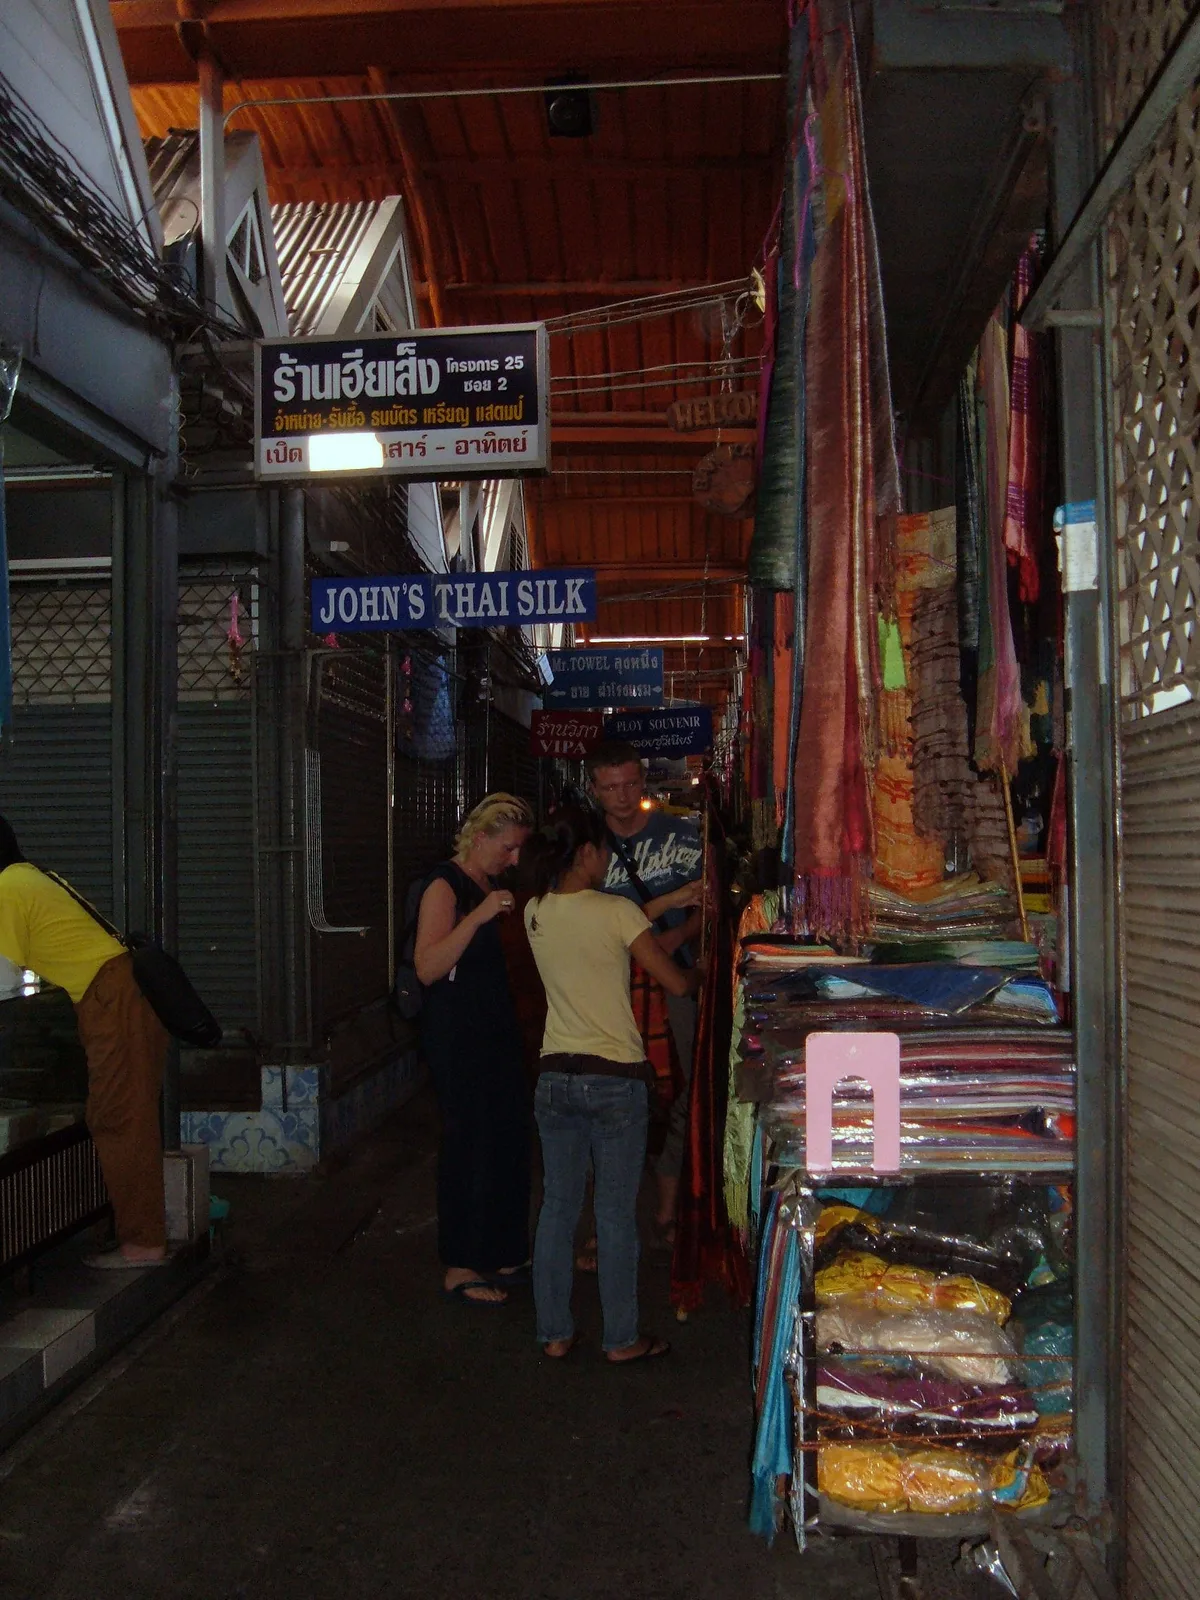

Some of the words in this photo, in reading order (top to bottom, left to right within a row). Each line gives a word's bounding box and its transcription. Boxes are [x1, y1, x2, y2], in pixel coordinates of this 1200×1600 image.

[273, 342, 441, 403] ร้านเฮียเส็ง
[446, 357, 499, 374] โครงการ
[505, 355, 525, 371] 25
[464, 380, 492, 393] ซอย
[498, 377, 509, 392] 2
[371, 403, 418, 427] ธนบัตร
[424, 401, 470, 428] เหรียญ
[266, 441, 303, 464] เปิด
[455, 430, 529, 456] อาทิตย์
[320, 581, 426, 625] JOHN'S
[435, 580, 510, 619] THAI
[517, 578, 588, 617] SILK
[615, 719, 644, 733] PLOY
[649, 715, 701, 732] SOUVENIR
[540, 739, 588, 755] VIPA
